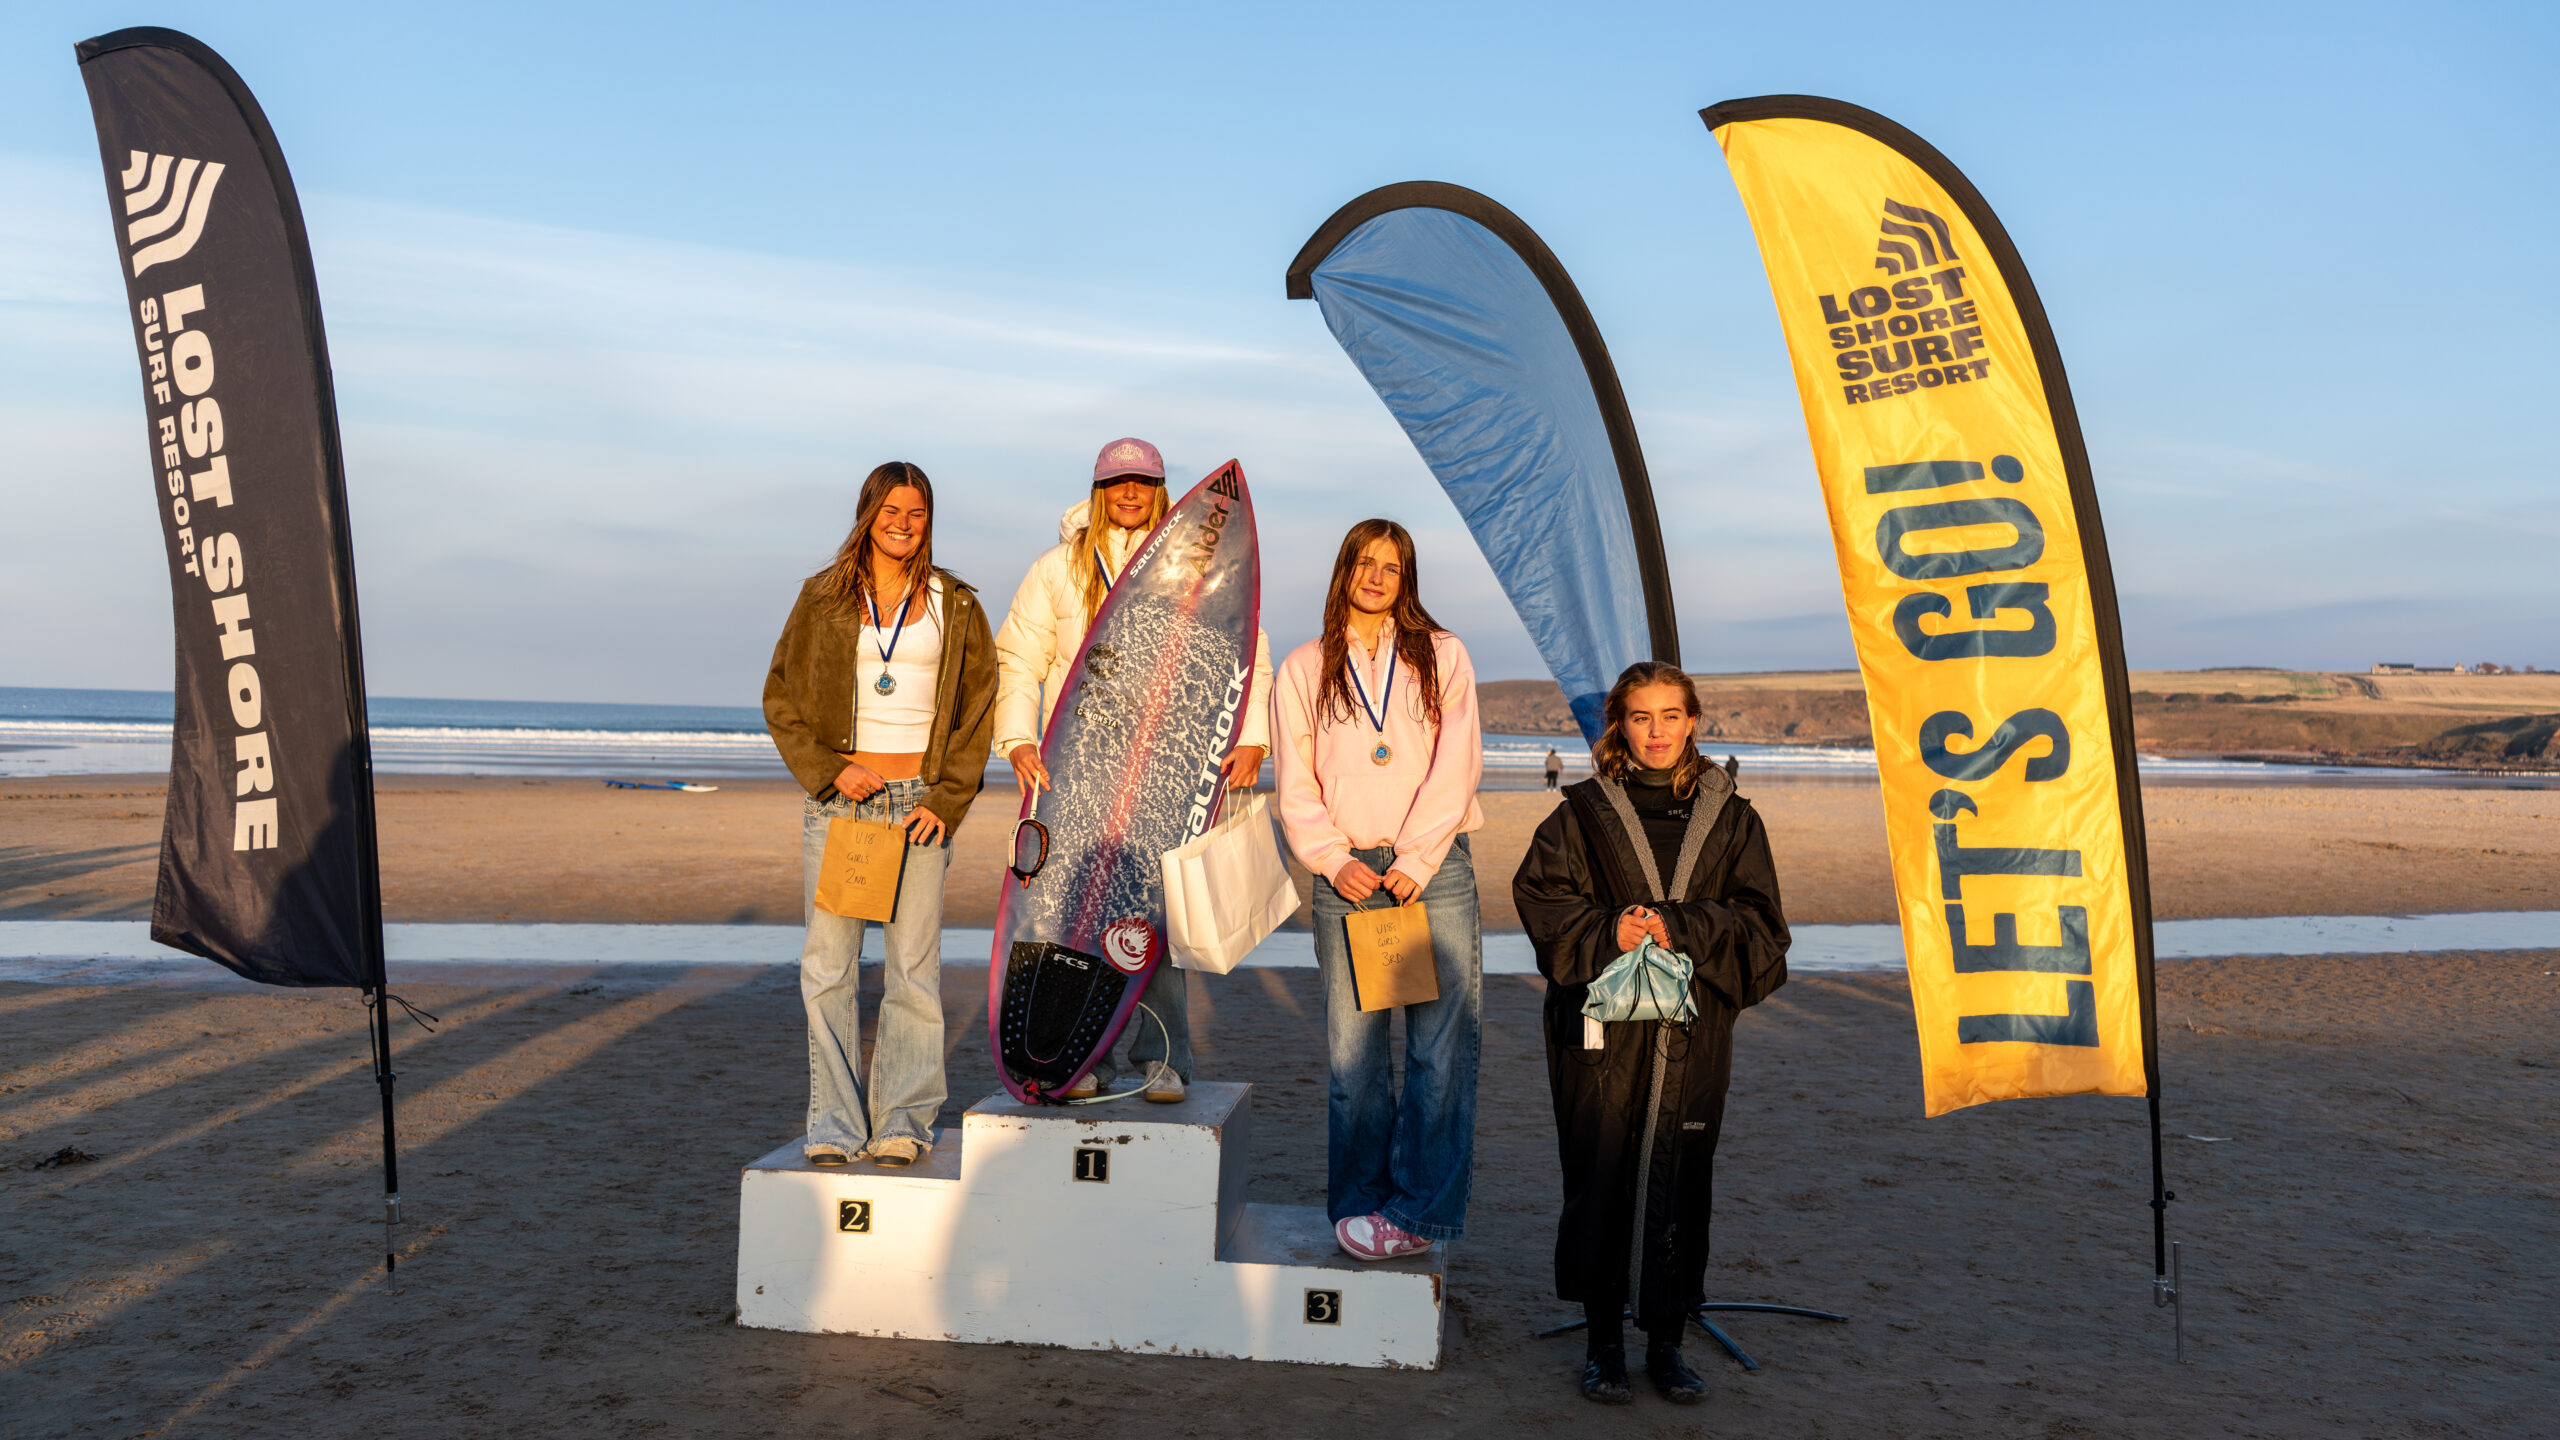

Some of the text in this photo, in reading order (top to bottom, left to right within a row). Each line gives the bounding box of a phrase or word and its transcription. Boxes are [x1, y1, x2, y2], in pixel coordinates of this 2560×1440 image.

[1818, 266, 1967, 325] LOST
[1828, 299, 1979, 350] SHORE
[1836, 325, 1985, 382] SURF
[1843, 357, 1991, 406] RESORT
[140, 297, 201, 578] SURF RESORT
[162, 282, 280, 852] LOST SHORE
[1187, 502, 1229, 578] Alder
[1864, 453, 2100, 1048] LET'S GO!
[1053, 953, 1090, 970] FCS
[1083, 1151, 1100, 1179] 1
[844, 1202, 865, 1230] 2
[1311, 1293, 1332, 1321] 3
